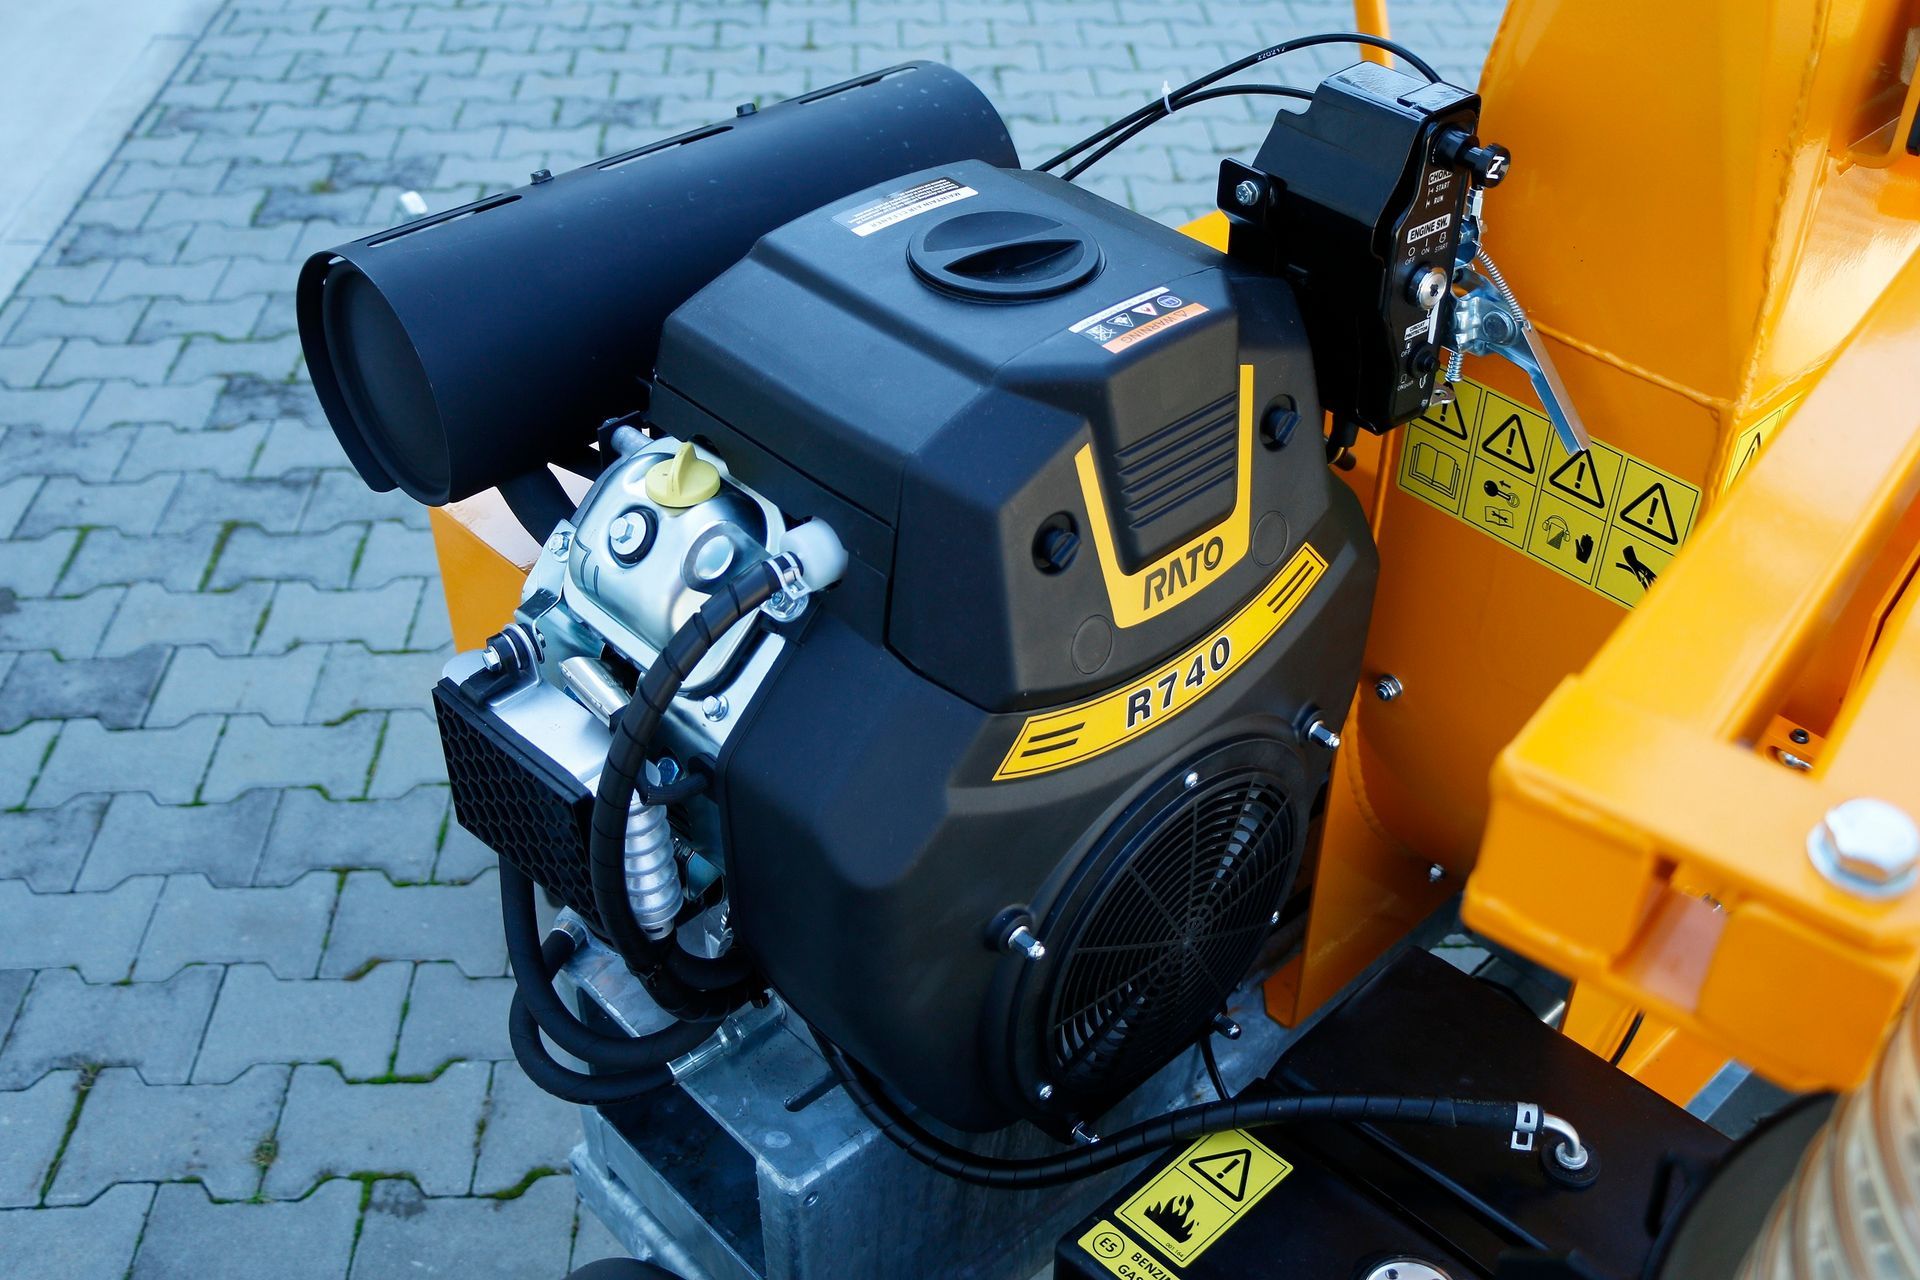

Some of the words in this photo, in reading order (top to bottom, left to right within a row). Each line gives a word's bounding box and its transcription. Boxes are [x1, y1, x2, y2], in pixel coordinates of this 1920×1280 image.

[1435, 181, 1450, 192] START
[923, 192, 961, 207] MAINTAIN
[1410, 222, 1435, 239] ENGINE
[1404, 256, 1416, 266] OFF
[1421, 247, 1430, 256] ON
[1434, 242, 1448, 253] START
[1120, 315, 1177, 344] WARNING
[1143, 536, 1224, 611] RATO
[1126, 636, 1230, 729] R740
[1099, 1237, 1118, 1253] E5
